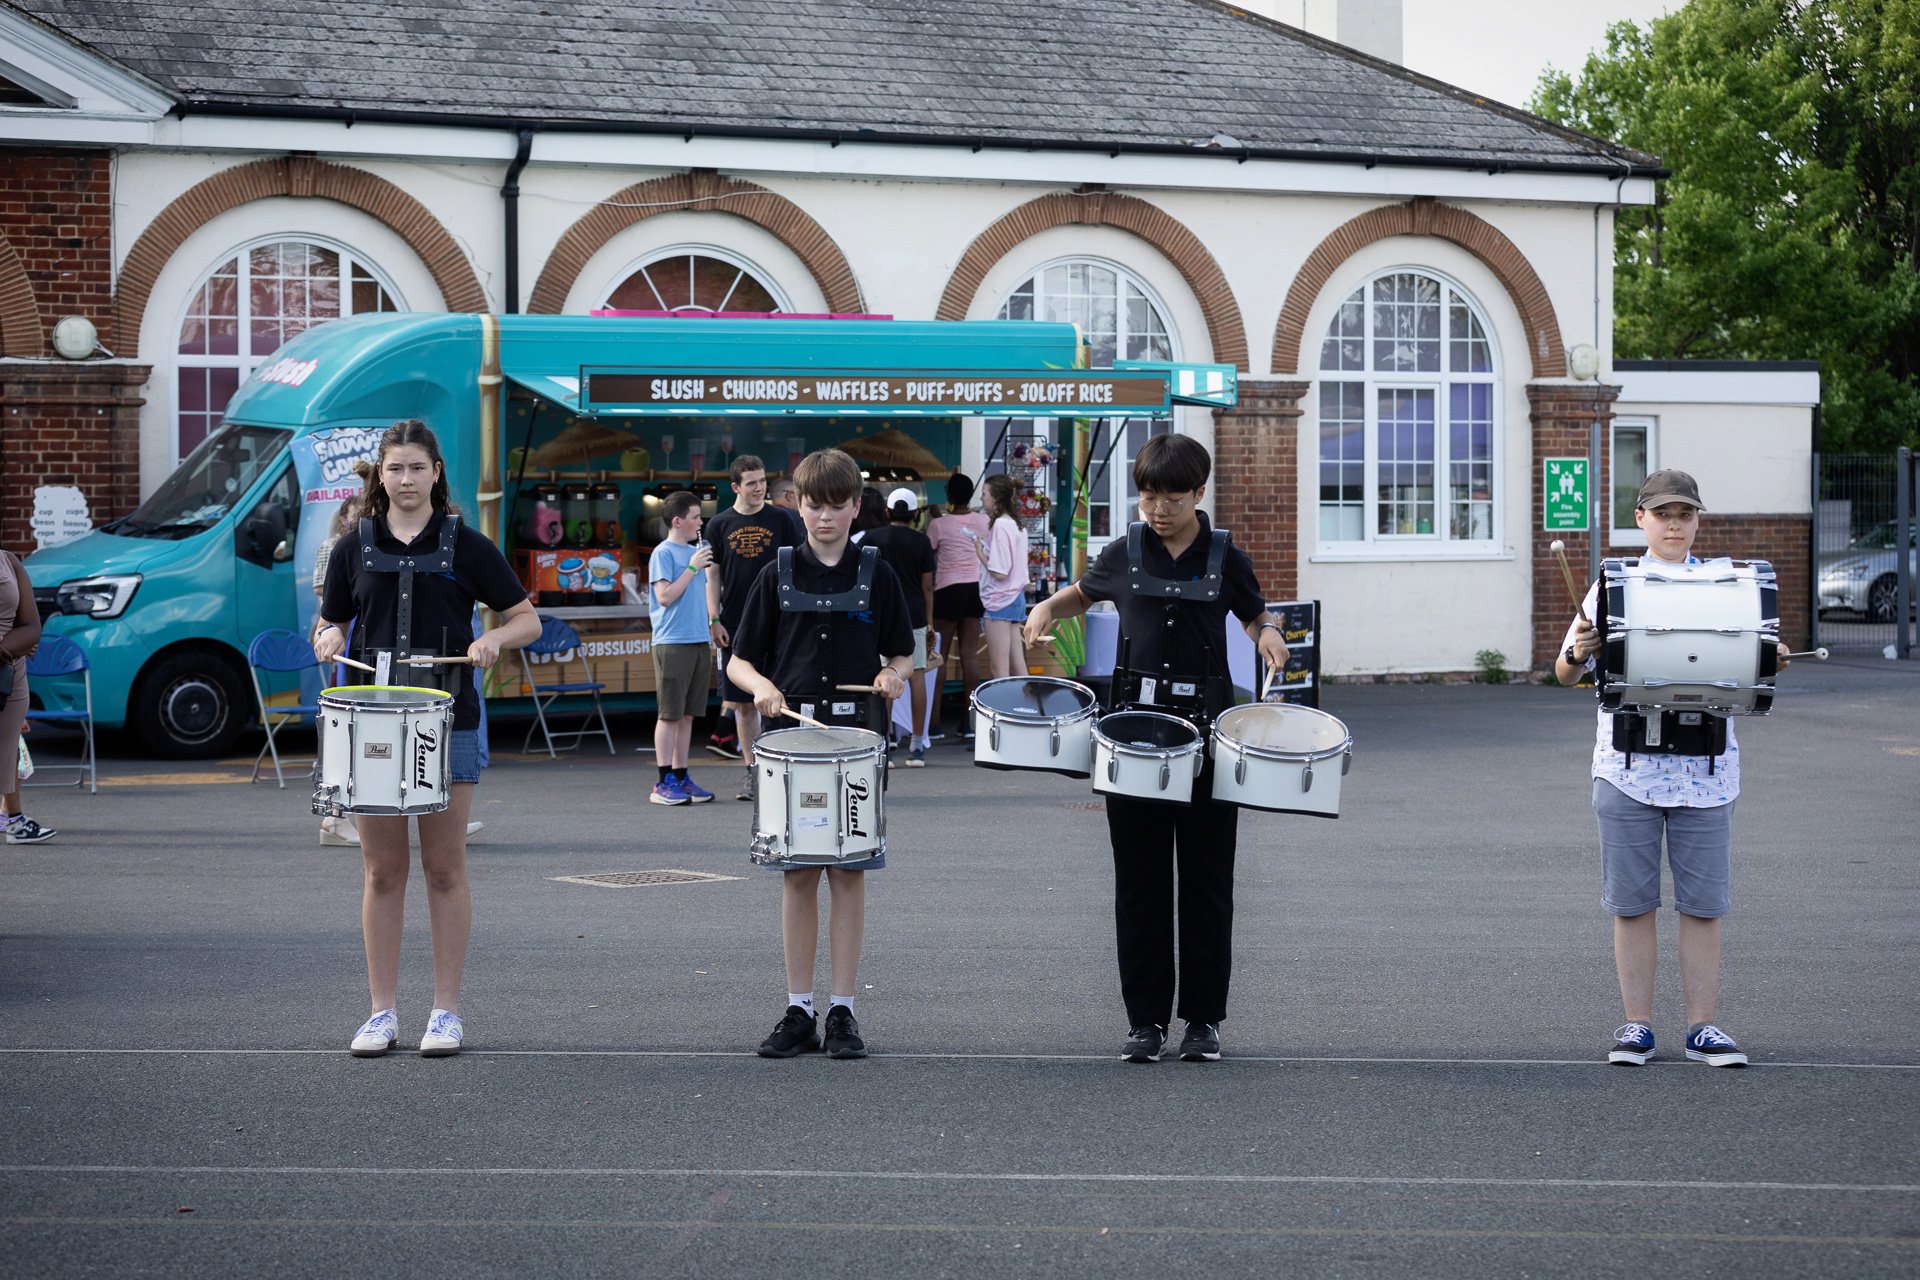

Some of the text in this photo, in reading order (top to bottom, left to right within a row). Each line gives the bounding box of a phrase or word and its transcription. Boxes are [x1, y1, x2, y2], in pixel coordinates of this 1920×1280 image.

[651, 379, 705, 400] SLUSH
[722, 380, 798, 401] CHURROS
[816, 381, 890, 401] WAFFLES
[906, 381, 1003, 402] PUFF-PUFFS
[1019, 383, 1075, 402] JOLOFF
[1079, 383, 1113, 403] RICE
[38, 509, 84, 517] cup cups
[34, 518, 88, 528] bean beans
[414, 720, 438, 790] Pearl
[803, 794, 824, 804] Pearl
[844, 771, 870, 838] Pearl
